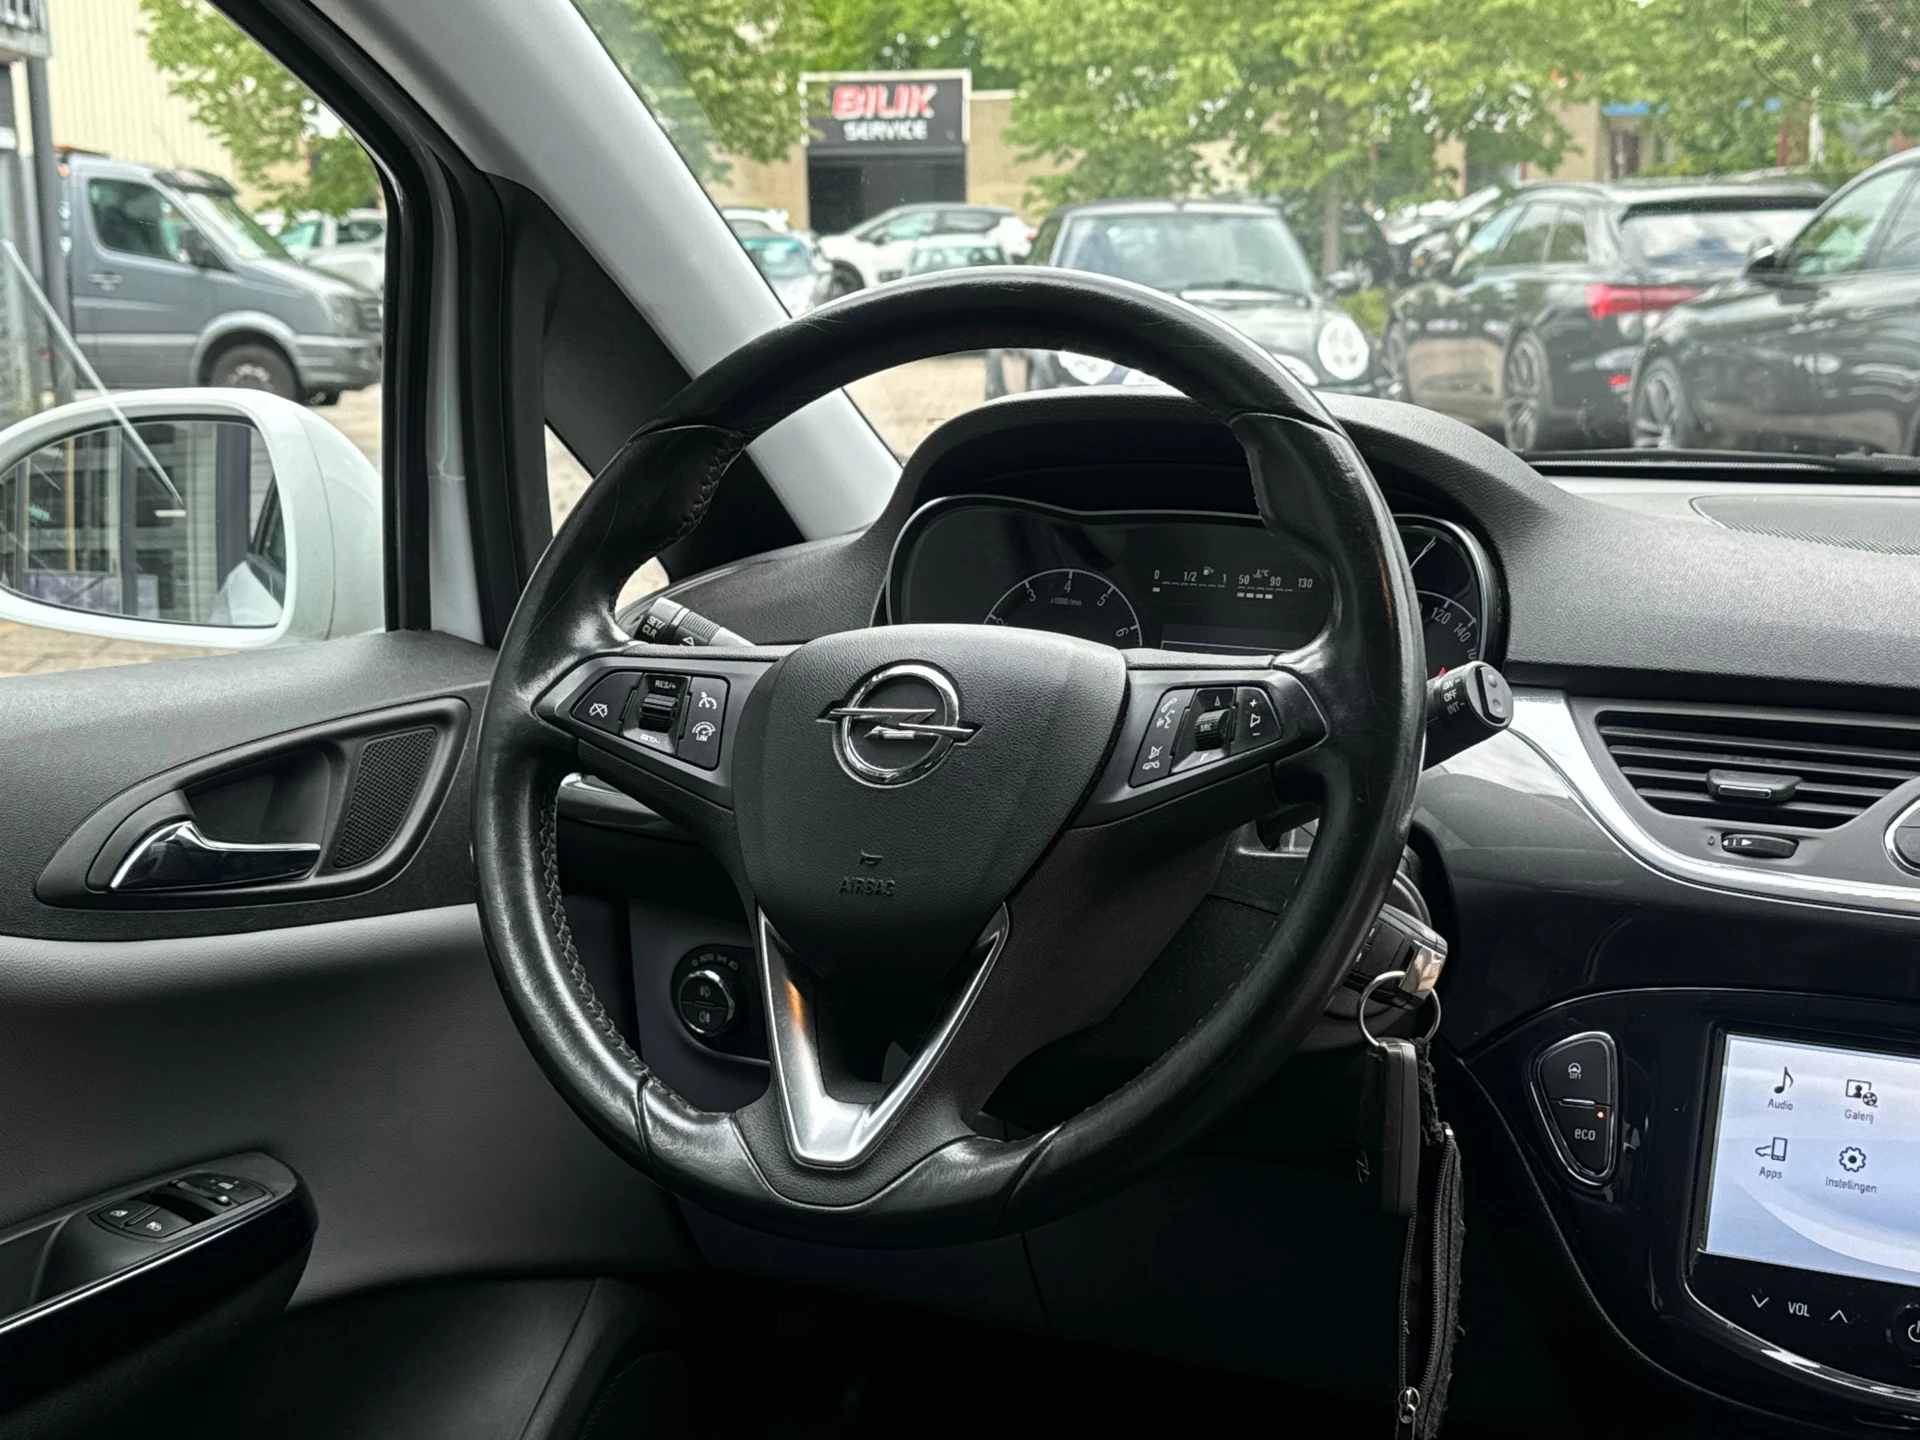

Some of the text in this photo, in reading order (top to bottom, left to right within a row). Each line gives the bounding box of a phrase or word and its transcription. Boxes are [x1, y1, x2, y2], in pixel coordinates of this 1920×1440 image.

[843, 120, 928, 141] SERVICE
[1184, 571, 1197, 582] 1/2
[1238, 574, 1313, 588] 50 90 130
[1064, 580, 1072, 593] 4
[1027, 588, 1036, 602] 3
[1097, 594, 1109, 607] 5
[647, 615, 665, 629] SET/
[1431, 606, 1451, 625] 120
[642, 624, 657, 639] CLR
[1115, 627, 1129, 637] 6
[1452, 622, 1471, 643] 140
[1443, 680, 1454, 690] ON
[1443, 689, 1457, 702] OFF
[839, 876, 896, 896] AIRBAG
[1767, 1098, 1794, 1111] Audio
[1844, 1108, 1874, 1125] Galerij
[1574, 1128, 1596, 1141] eco
[1759, 1166, 1783, 1180] Apps
[1788, 1301, 1811, 1318] VOL
